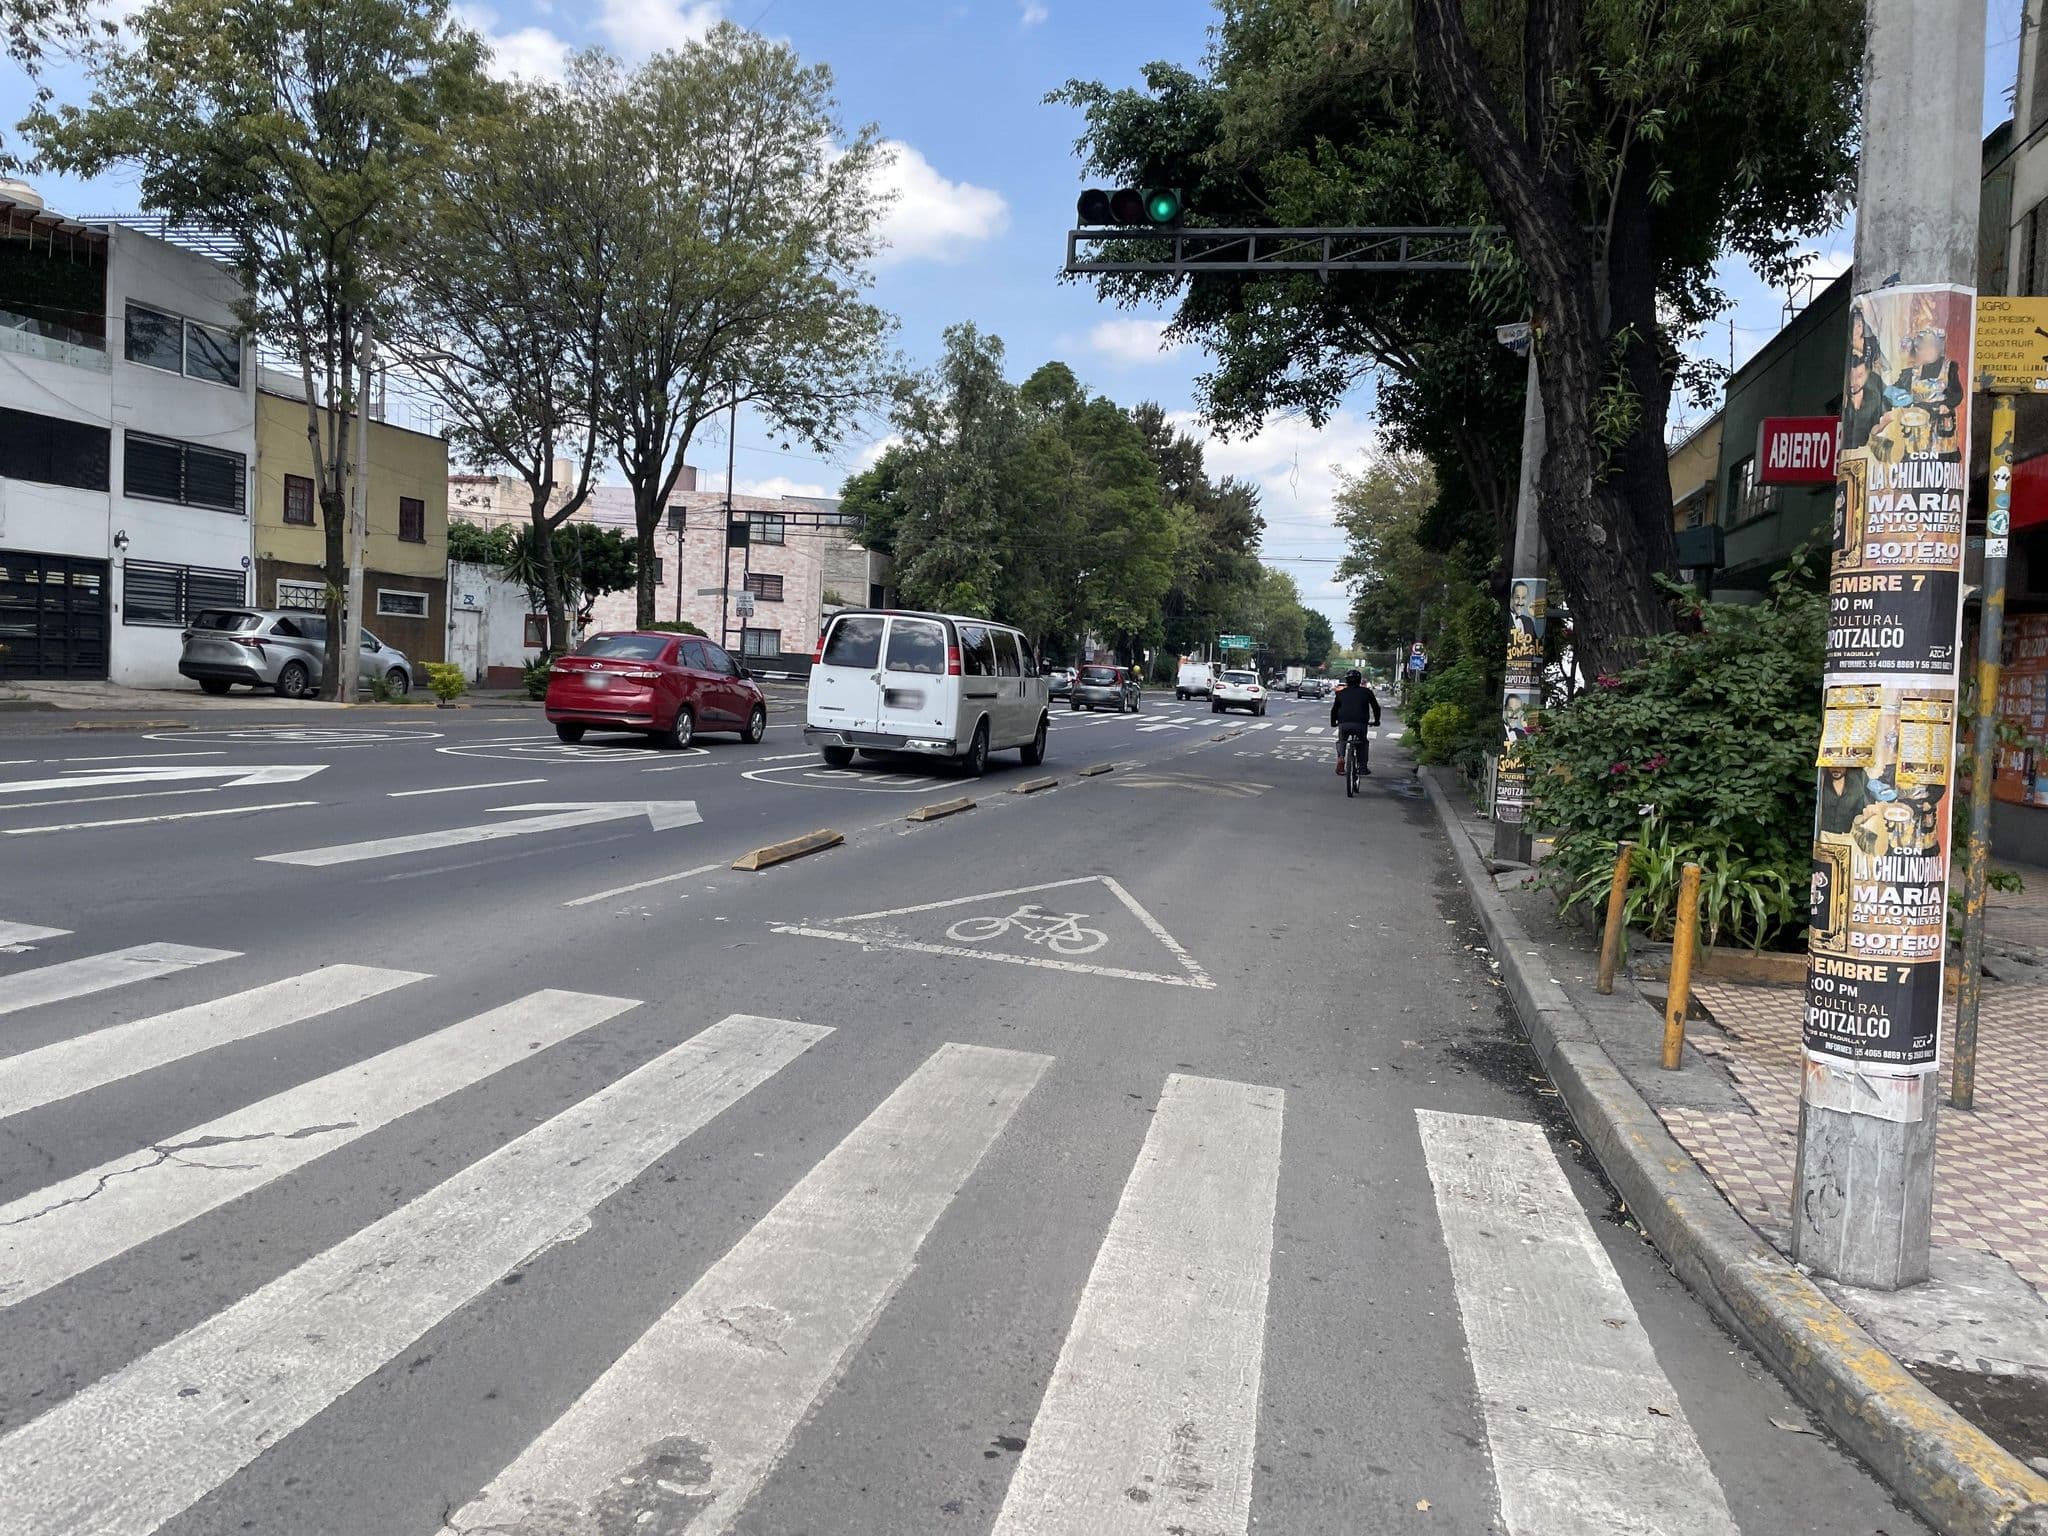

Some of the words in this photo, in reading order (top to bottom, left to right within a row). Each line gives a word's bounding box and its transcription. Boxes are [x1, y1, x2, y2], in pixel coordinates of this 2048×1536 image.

[1977, 327, 2024, 335] EXCAVAR
[1976, 340, 2033, 348] CONSTRUIR
[1976, 352, 2025, 360] GOLPEAR
[1996, 376, 2033, 384] MEXICO
[1768, 431, 1830, 468] ABIERTO
[1909, 451, 1939, 460] CON
[1868, 463, 1885, 490] LA
[1888, 460, 1963, 489] CHILINDRINA
[1868, 487, 1961, 512] MARÍA
[1868, 512, 1961, 524] ANTONIETA
[1867, 524, 1885, 533] DE
[1888, 524, 1918, 532] LAS
[1923, 524, 1960, 533] NIEVES
[1916, 533, 1924, 541] Y
[1866, 542, 1959, 559] BOTERO
[1911, 575, 1926, 591] 7
[1853, 598, 1874, 610] PM
[1893, 847, 1922, 855] CON
[1854, 855, 1868, 880] LA
[1873, 856, 1942, 883] CHILINDRINA
[1854, 883, 1941, 905] MARÍA
[1853, 903, 1941, 917] ANTONIETA
[1853, 914, 1869, 923] DE
[1874, 916, 1902, 925] LAS
[1907, 917, 1941, 926] NIEVES
[1901, 926, 1909, 934] Y
[1851, 932, 1940, 950] BOTERO
[1897, 968, 1911, 983] 7
[1839, 983, 1858, 997] PM
[1814, 995, 1889, 1016] CULTURAL
